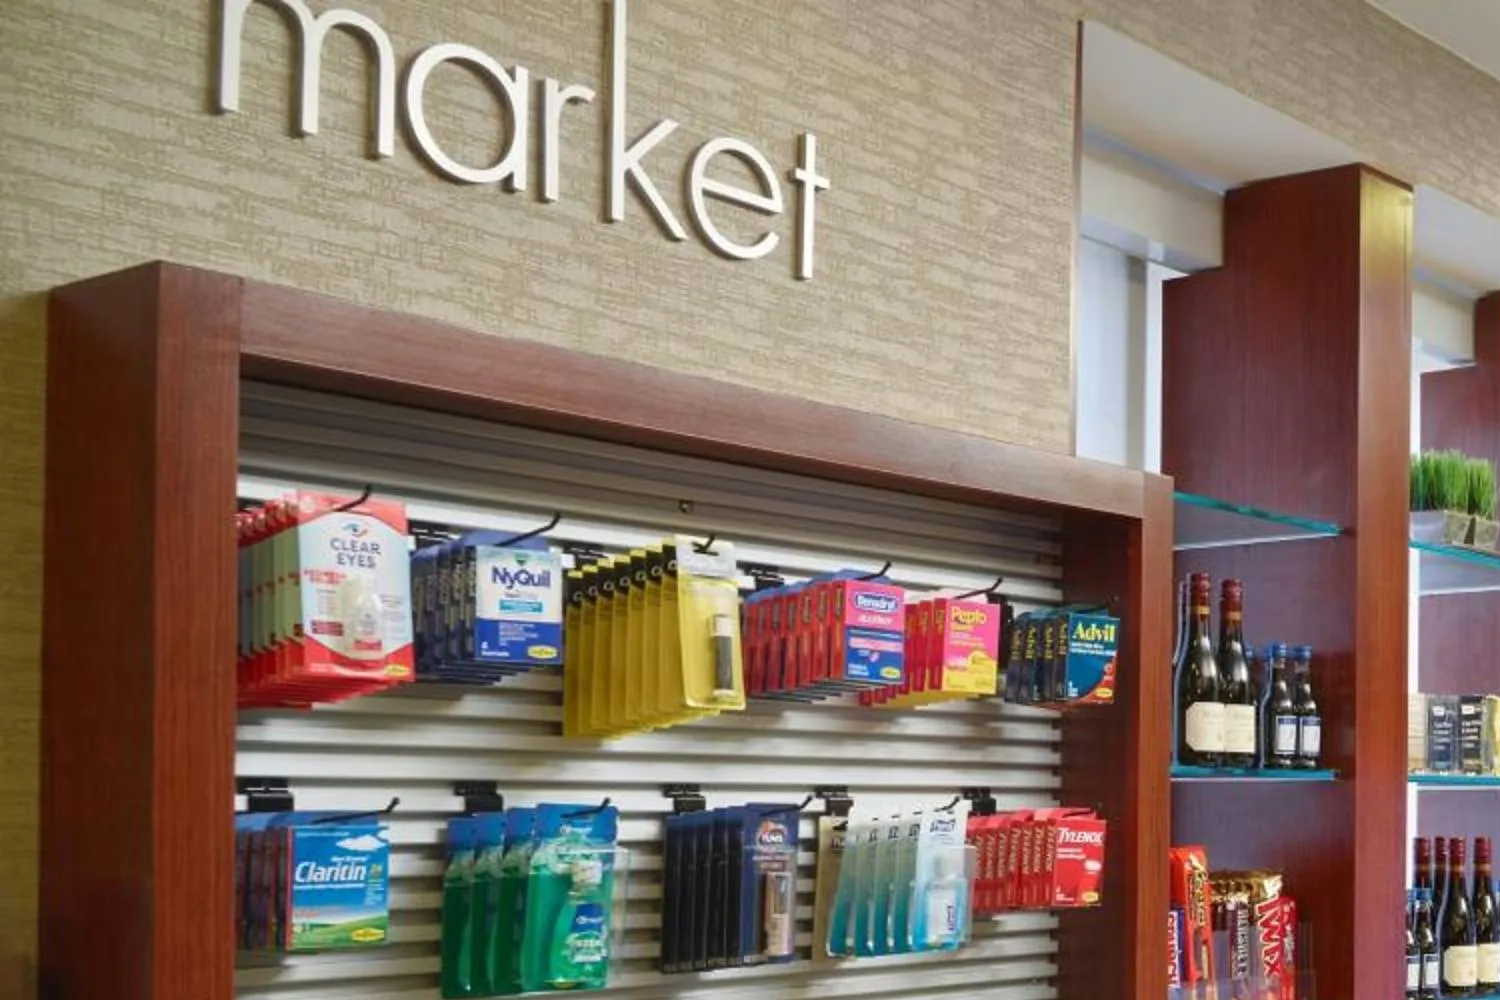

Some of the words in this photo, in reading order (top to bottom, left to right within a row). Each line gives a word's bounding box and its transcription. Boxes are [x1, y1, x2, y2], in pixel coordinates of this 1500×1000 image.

[219, 0, 831, 280] market
[330, 538, 381, 554] CLEAR
[337, 553, 377, 569] EYES
[491, 565, 552, 590] NyQuil
[951, 605, 987, 625] Pepto
[1071, 621, 1117, 643] Advil
[1056, 826, 1104, 845] TYLENOL
[295, 861, 367, 884] Claritin
